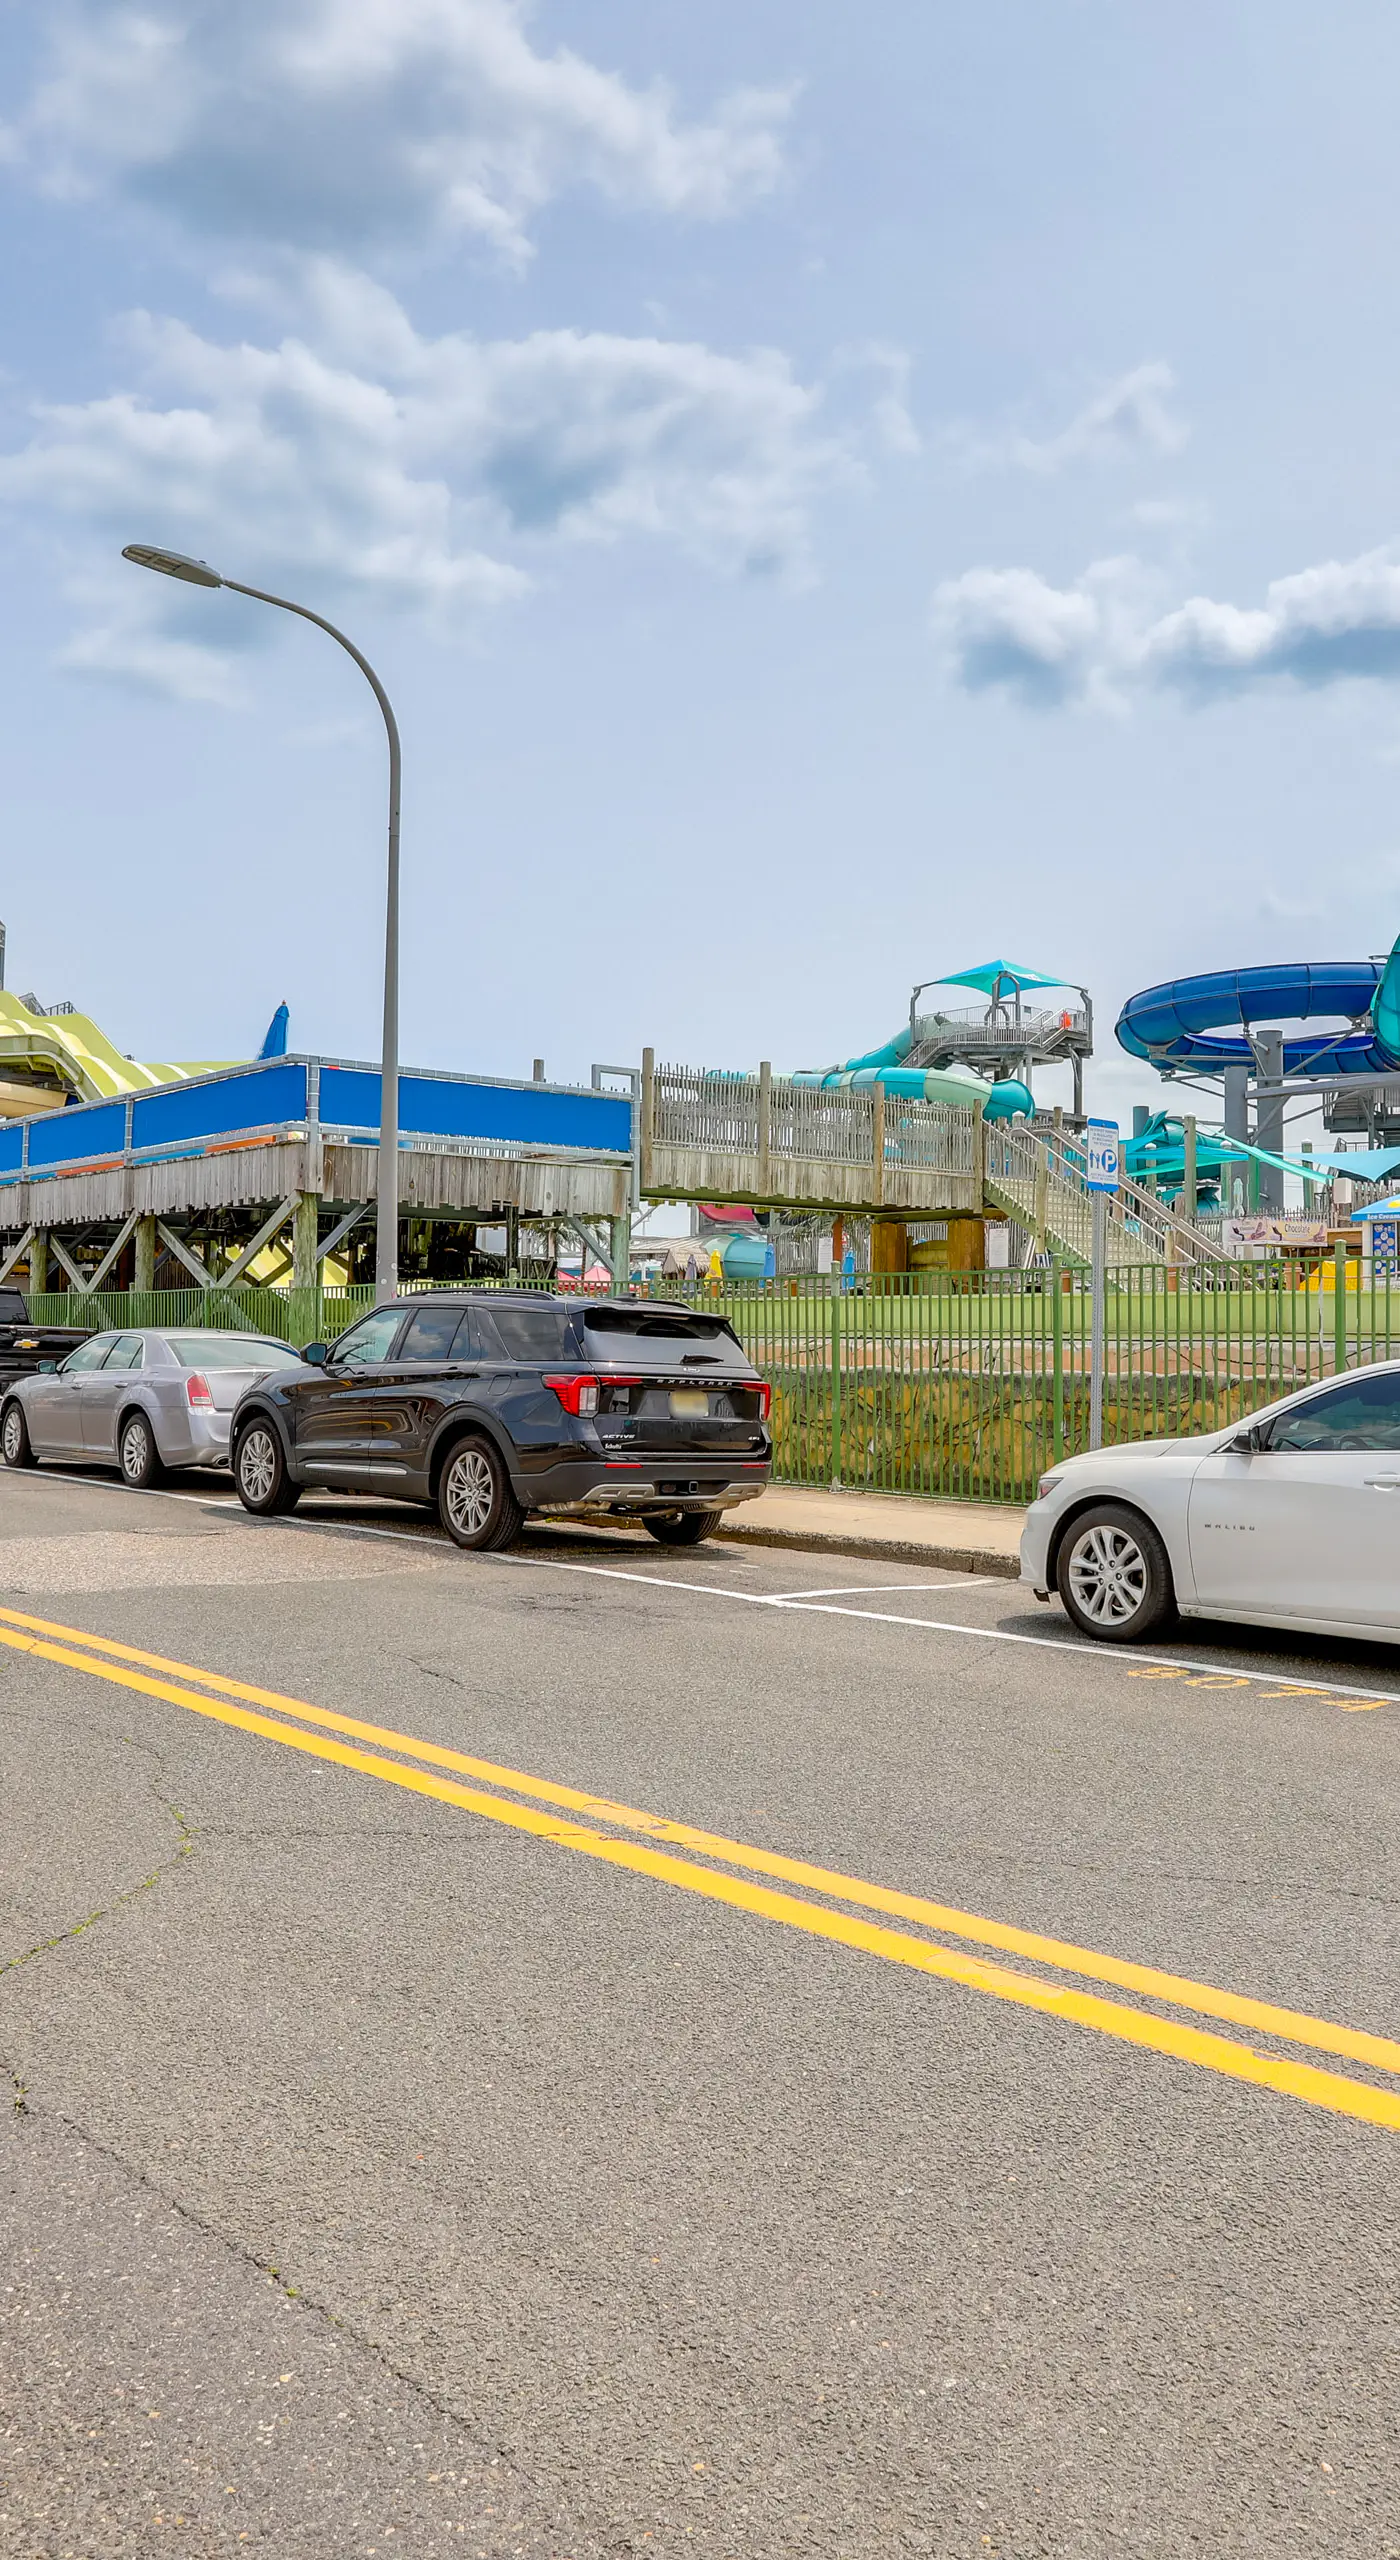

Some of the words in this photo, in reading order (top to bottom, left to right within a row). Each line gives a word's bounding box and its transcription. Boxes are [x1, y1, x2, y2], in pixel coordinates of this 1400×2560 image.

[1105, 1151, 1115, 1171] P
[1284, 1223, 1311, 1234] Chocolate
[1204, 1523, 1255, 1531] MALIBU
